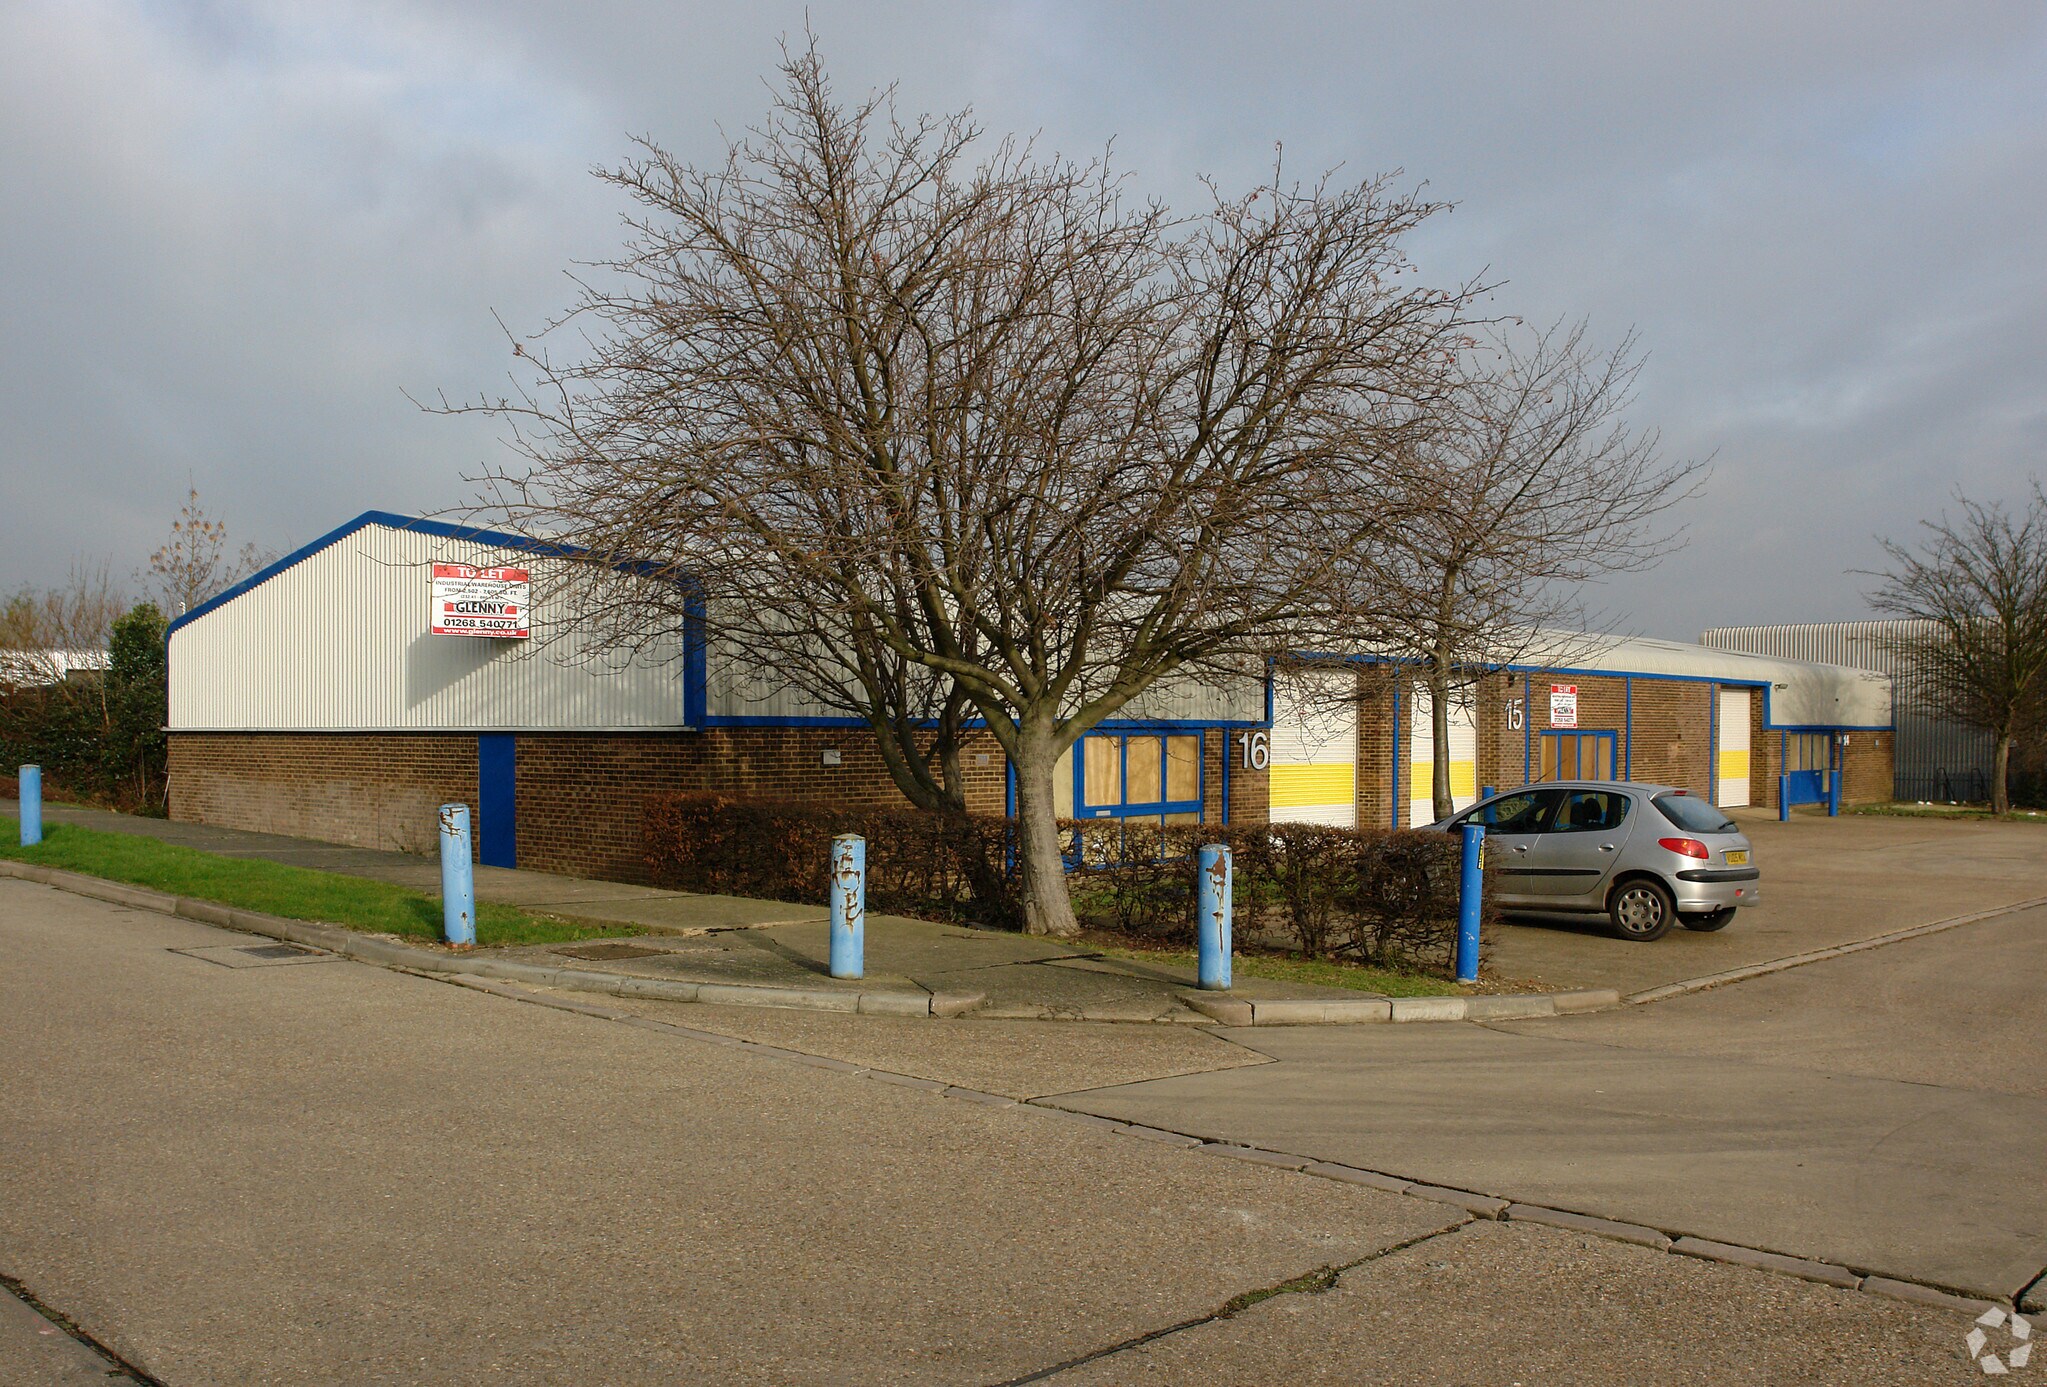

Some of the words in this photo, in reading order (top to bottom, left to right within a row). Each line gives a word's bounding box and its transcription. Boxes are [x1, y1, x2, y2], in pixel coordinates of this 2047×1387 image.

[457, 567, 476, 577] TO
[480, 568, 505, 579] LET
[456, 602, 505, 614] GLENNY
[444, 619, 475, 627] 01268
[480, 620, 517, 628] 540771
[1504, 698, 1523, 730] 15
[1239, 732, 1269, 770] 16
